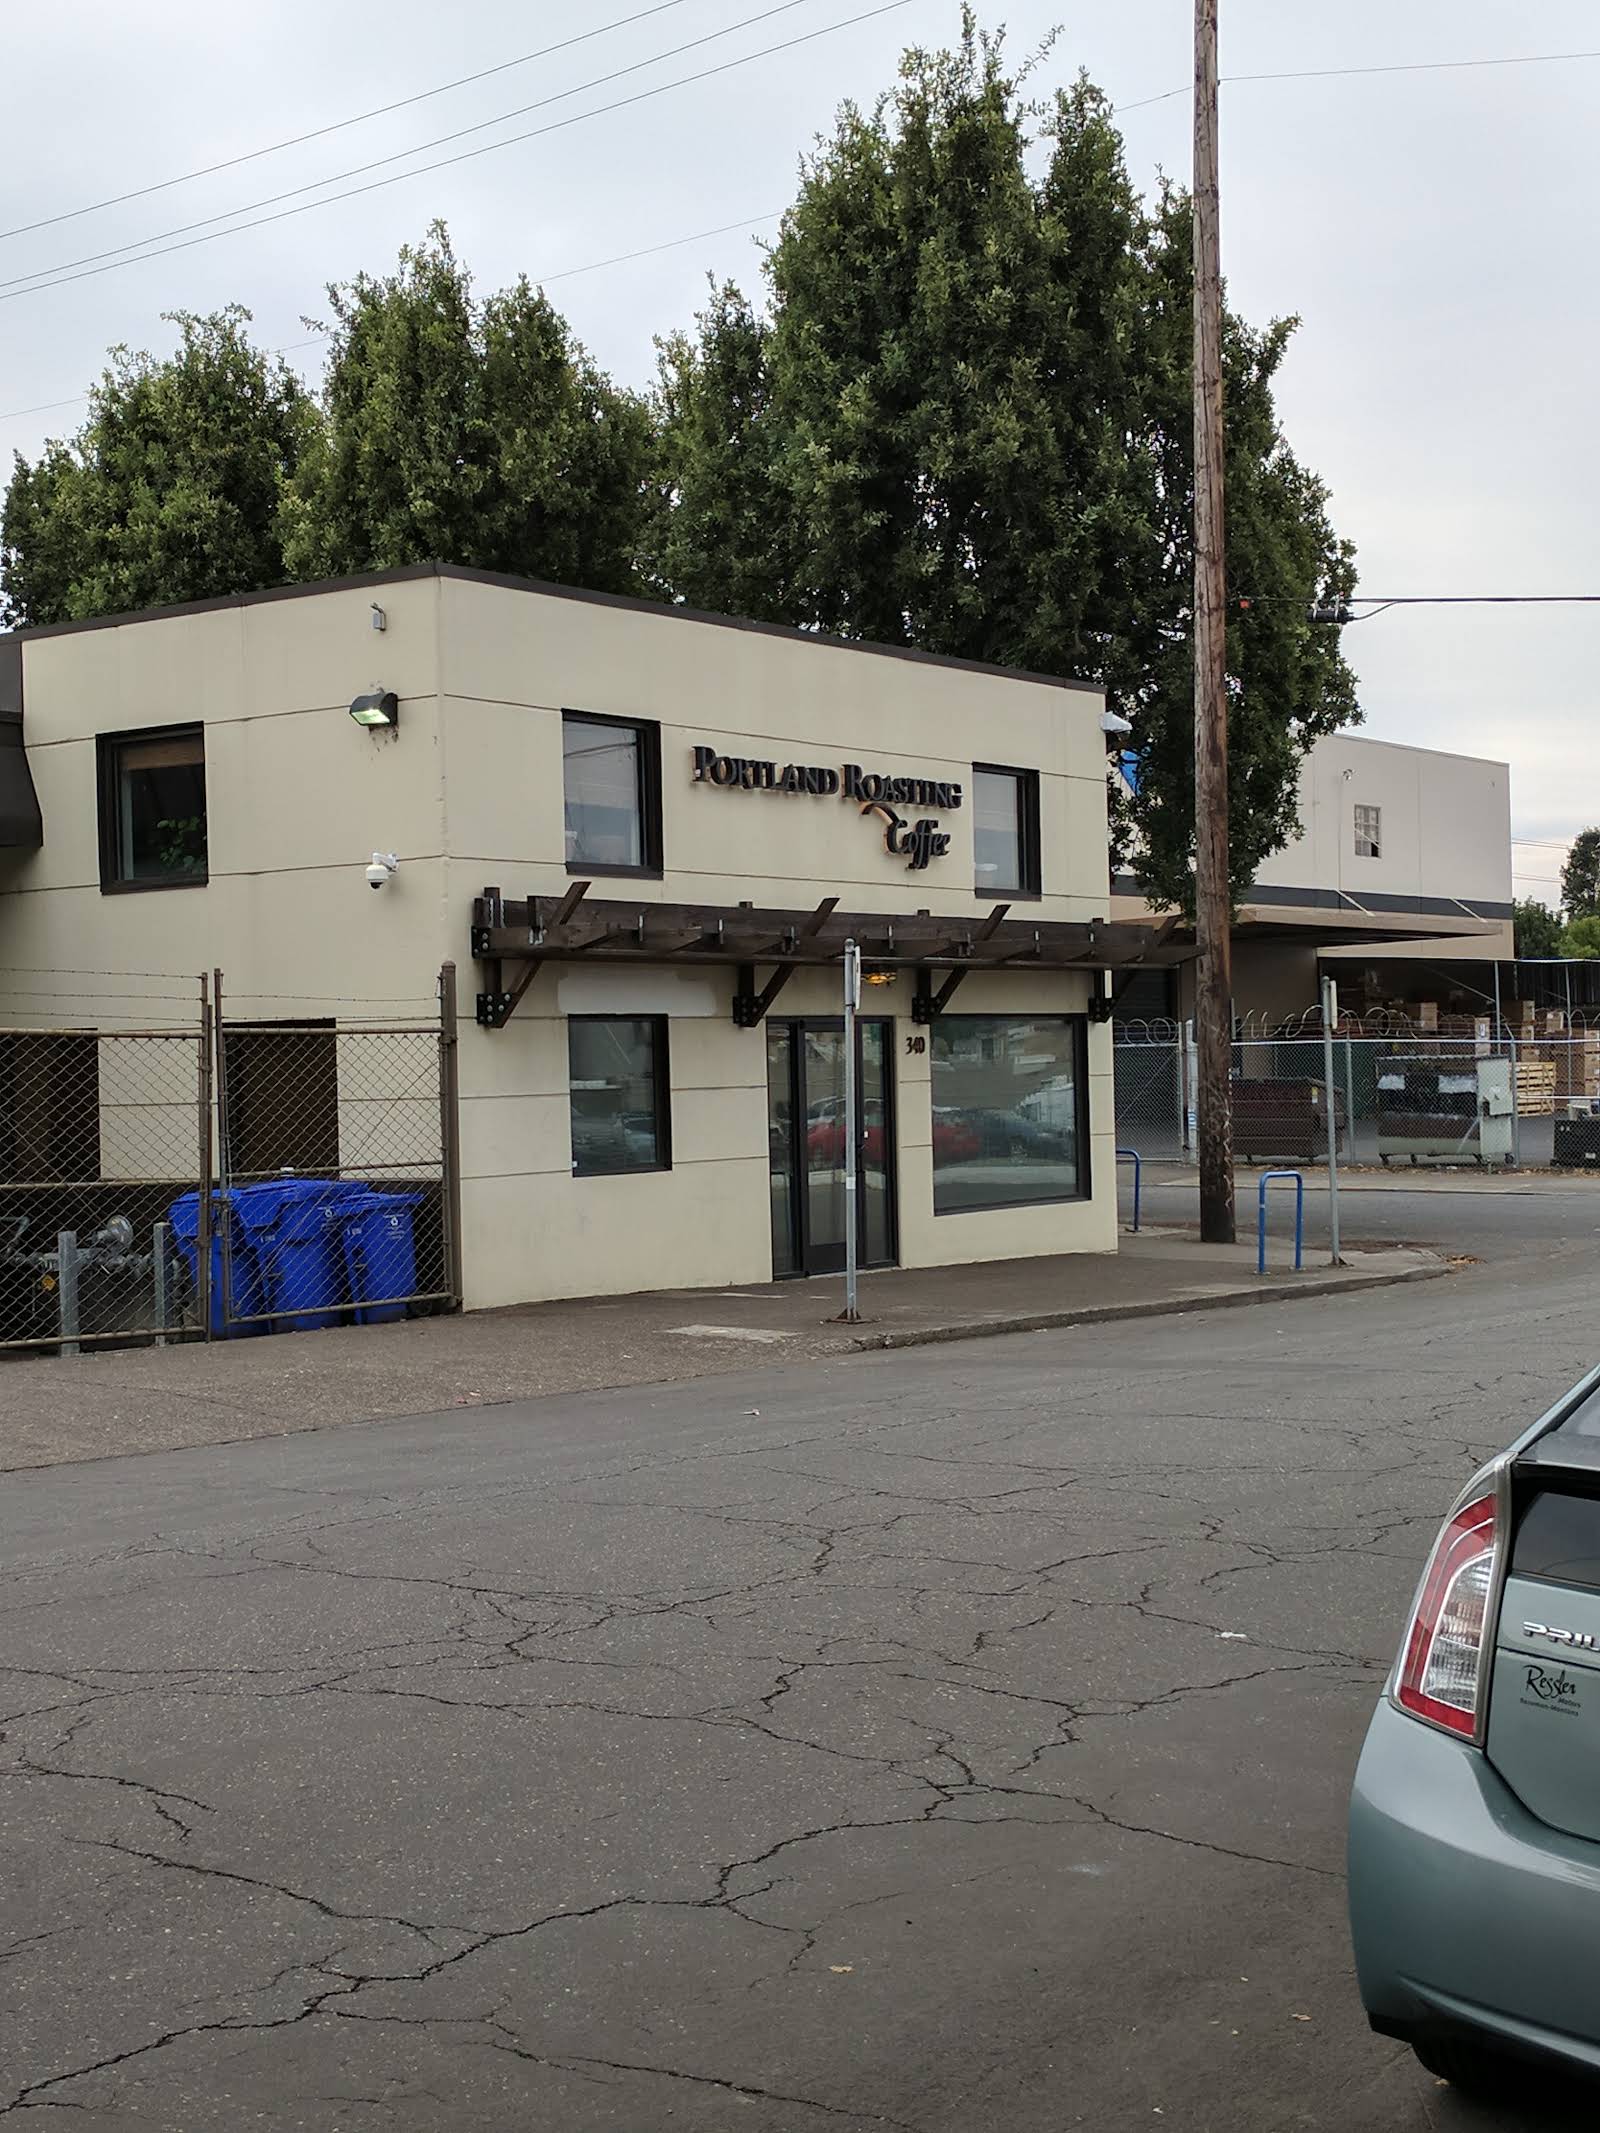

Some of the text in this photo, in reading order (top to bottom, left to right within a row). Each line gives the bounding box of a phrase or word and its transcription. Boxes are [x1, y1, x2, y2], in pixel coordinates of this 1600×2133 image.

[692, 745, 963, 808] PORTLAND ROASTING
[864, 803, 951, 870] Coffee
[905, 1036, 925, 1055] 340
